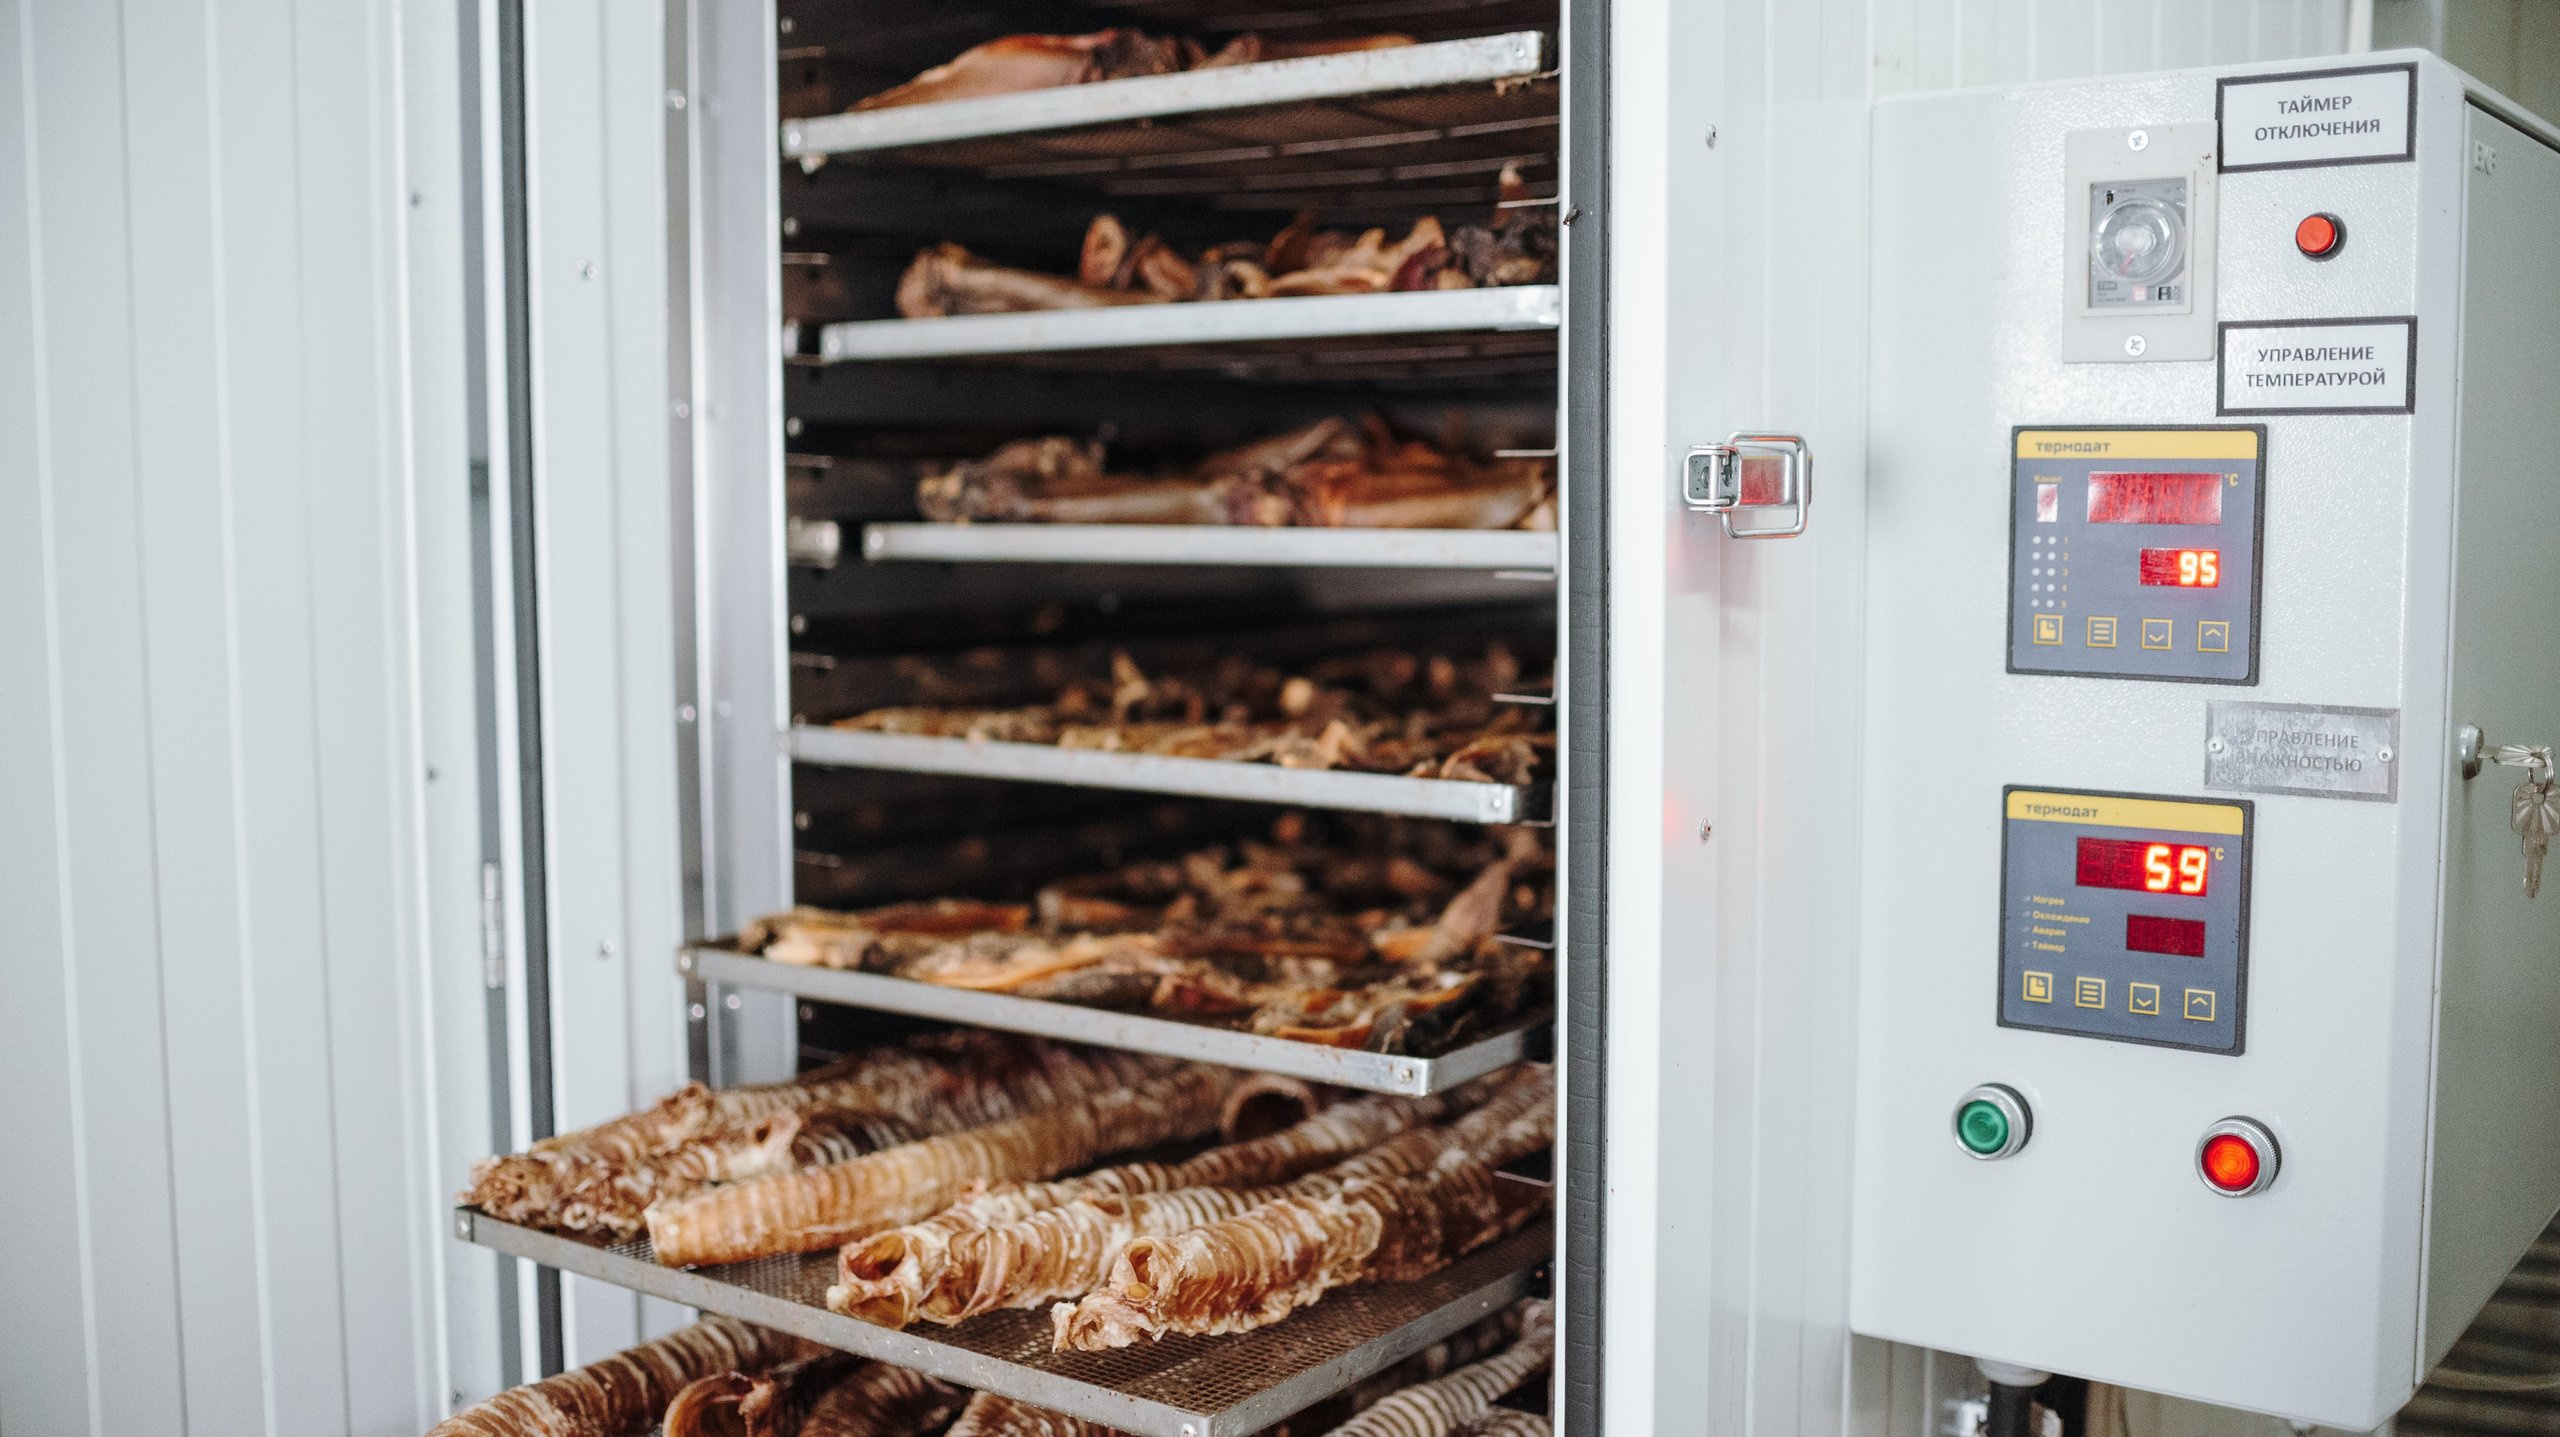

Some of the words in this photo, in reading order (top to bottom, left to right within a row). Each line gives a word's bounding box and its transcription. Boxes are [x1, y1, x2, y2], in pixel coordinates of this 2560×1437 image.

[2278, 95, 2352, 114] ТАЙМЕР
[2255, 119, 2380, 141] ОТКЛЮЧЕНИЯ
[2258, 346, 2374, 362] УПРАВЛЕНИЕ
[2246, 368, 2385, 387] ТЕМПЕРАТУРОЙ
[2035, 441, 2111, 454] термодат
[2179, 551, 2217, 585] 95
[2236, 751, 2363, 773] ВЛАЖНОСТЬЮ
[2025, 803, 2099, 818] термодат
[2146, 845, 2208, 893] 59
